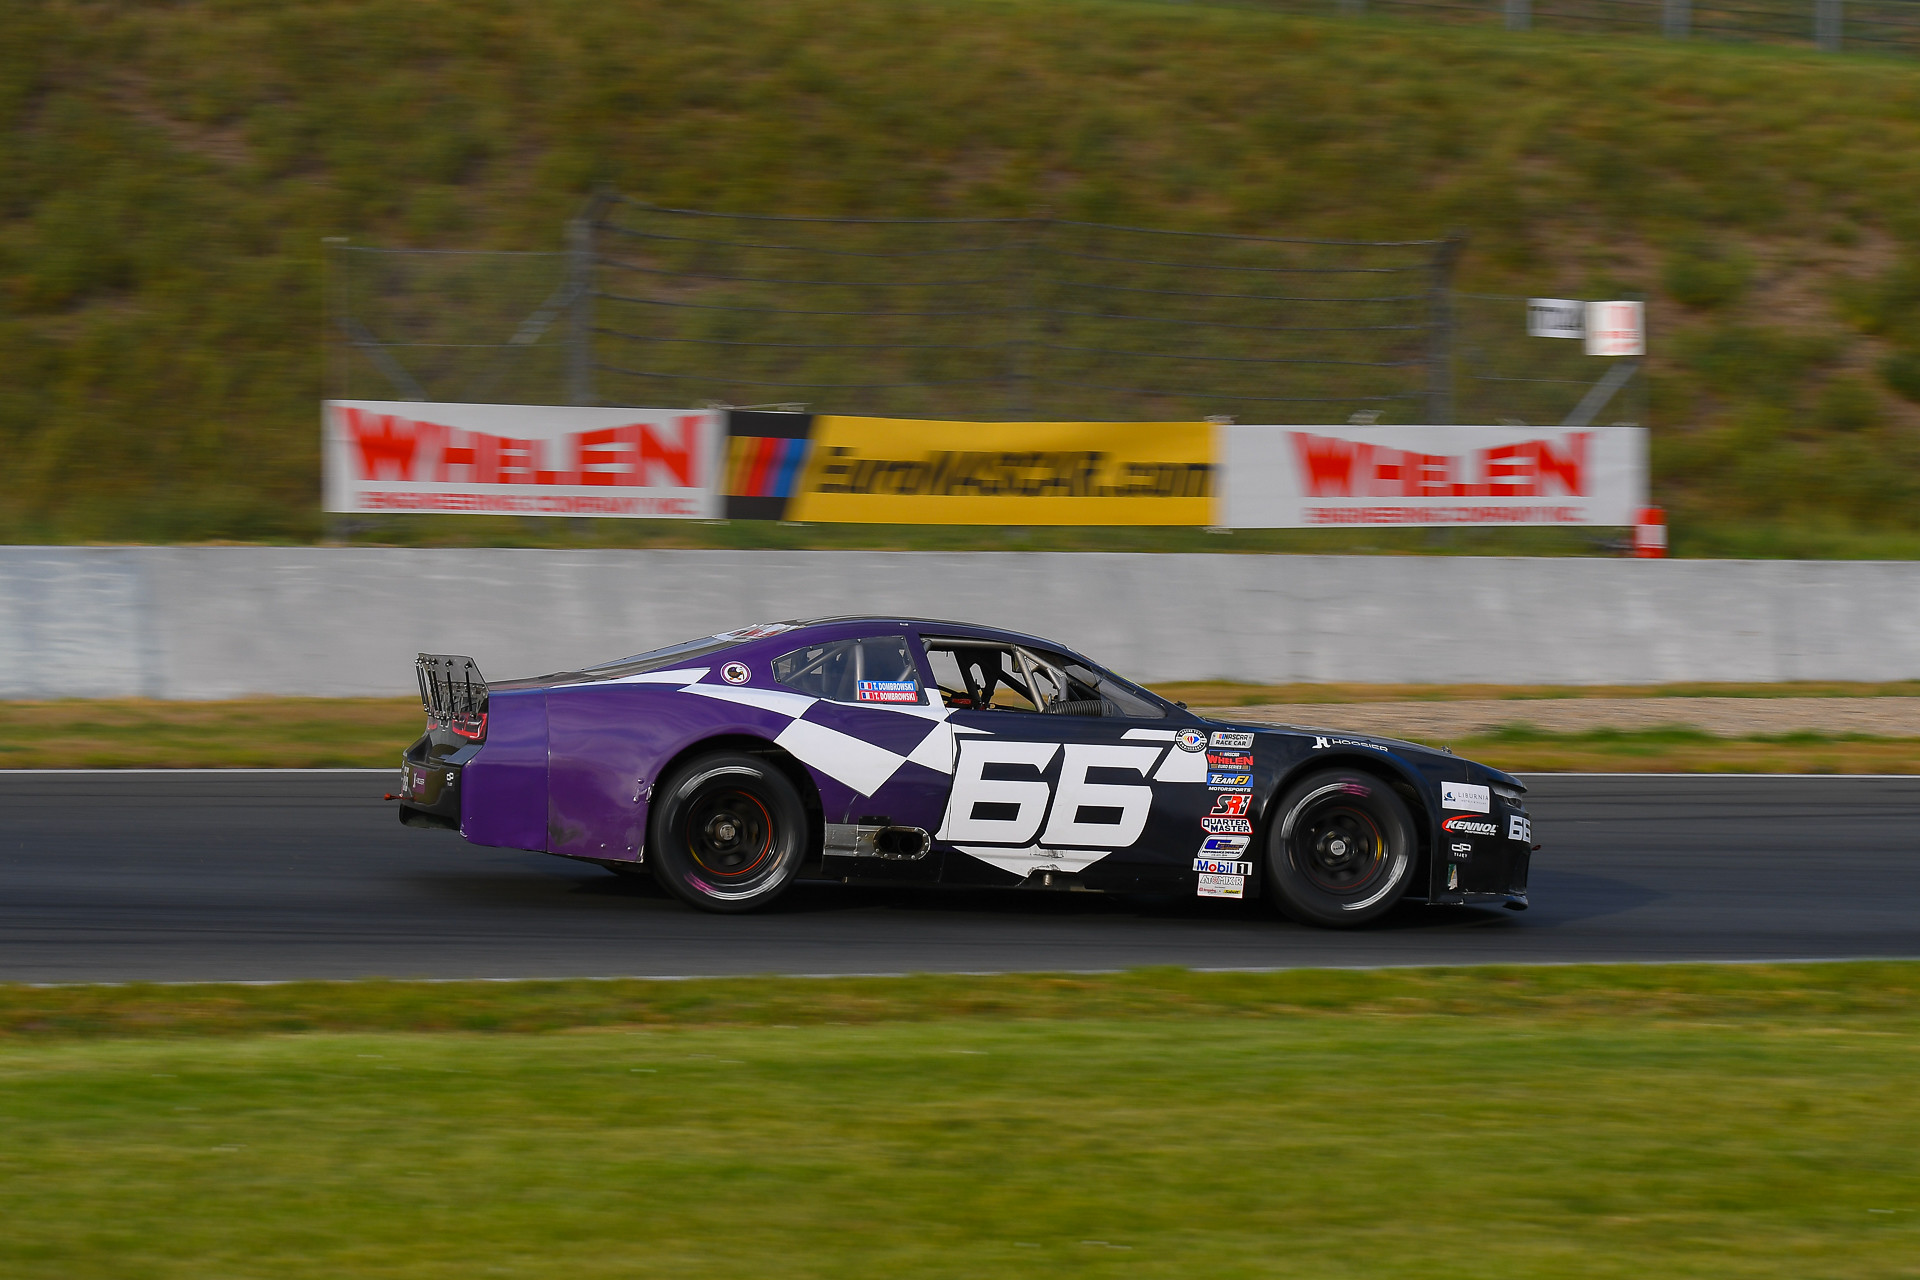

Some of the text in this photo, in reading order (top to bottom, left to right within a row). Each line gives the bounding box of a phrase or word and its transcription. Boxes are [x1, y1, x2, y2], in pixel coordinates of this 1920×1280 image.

[338, 406, 712, 487] WHELEN
[1289, 432, 1592, 497] WHELEN
[879, 683, 914, 691] DOMBROWSKI
[880, 693, 915, 701] DOMBROWSKI
[1223, 733, 1249, 741] NASCAR
[1332, 739, 1388, 752] HOOSIER
[1206, 754, 1254, 766] WHELEN
[935, 740, 1153, 847] 66
[1457, 792, 1489, 801] LIBURNIA
[1202, 818, 1248, 827] QUARTER
[1210, 823, 1250, 833] MASTER
[1445, 820, 1497, 833] KENNOL
[1508, 814, 1531, 843] 66
[1197, 860, 1233, 874] Mobil
